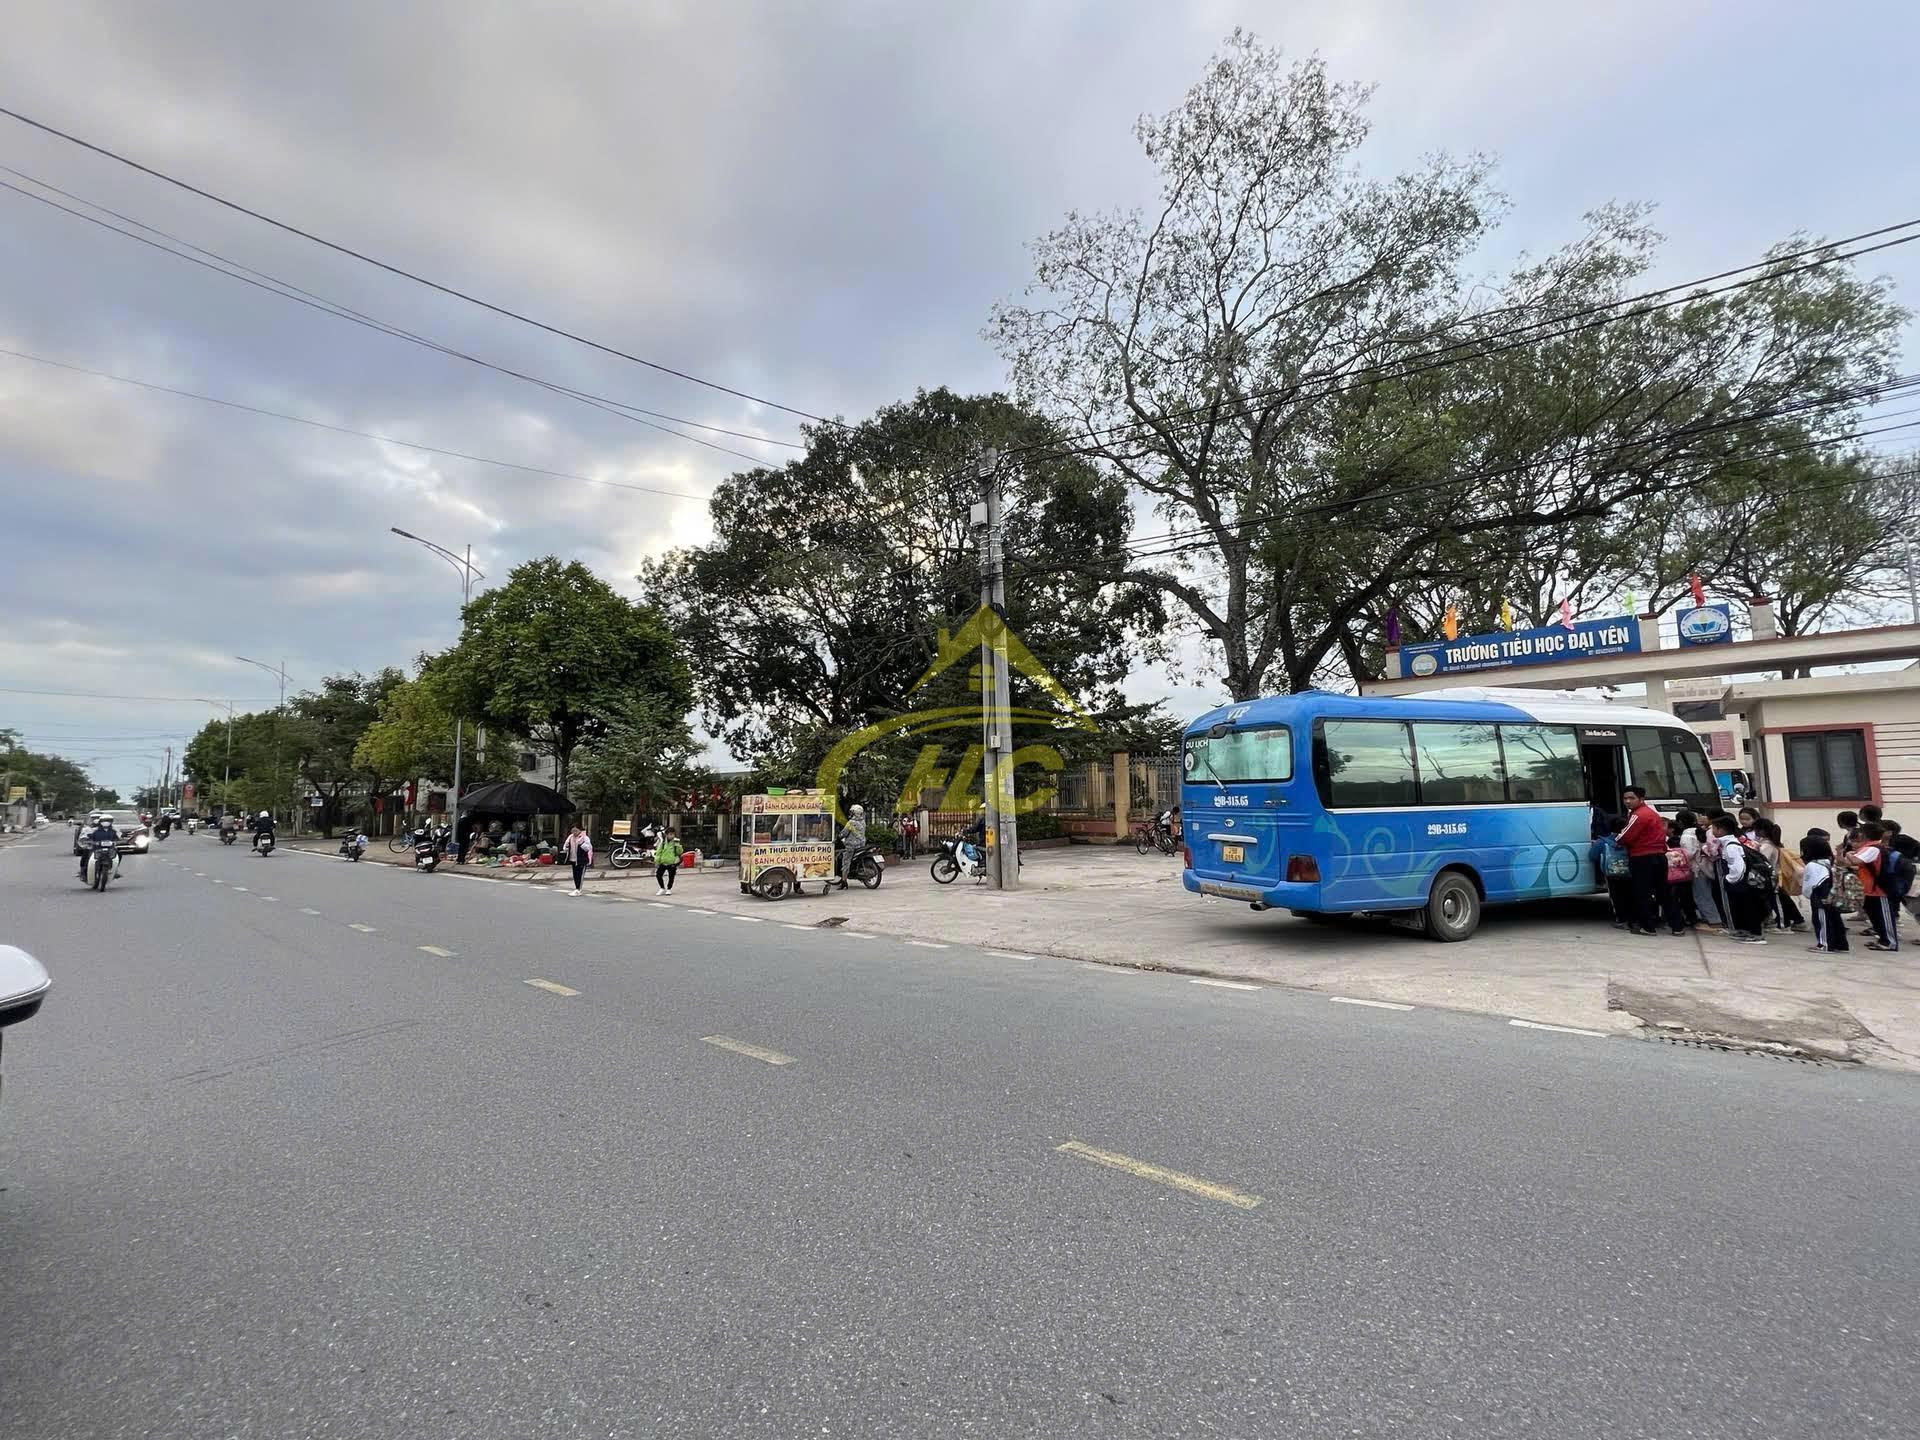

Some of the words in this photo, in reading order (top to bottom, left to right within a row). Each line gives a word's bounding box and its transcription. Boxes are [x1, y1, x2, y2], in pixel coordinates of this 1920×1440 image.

[1445, 642, 1499, 664] TRƯỜNG
[1501, 632, 1532, 657] TIỂU
[1535, 635, 1564, 656] HỌC
[1568, 631, 1595, 651] ĐẠI
[1598, 625, 1630, 646] YÊN
[1227, 706, 1252, 719] VIP
